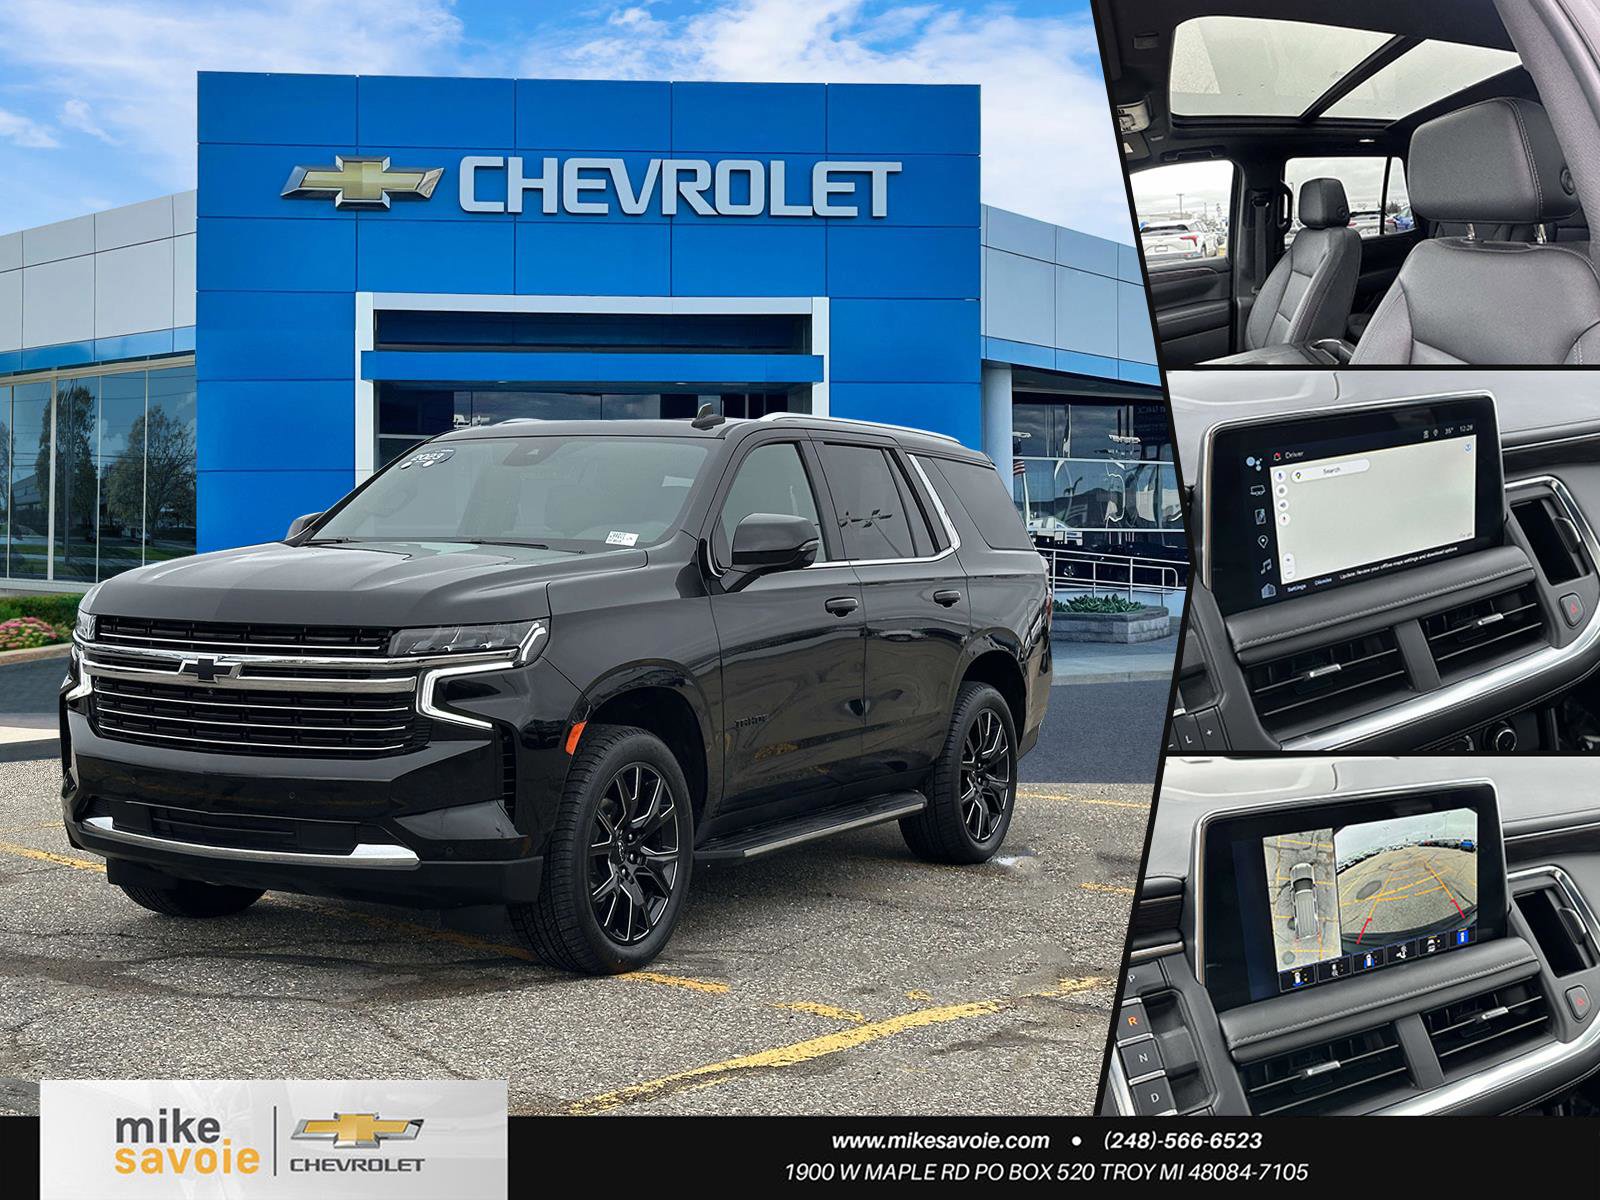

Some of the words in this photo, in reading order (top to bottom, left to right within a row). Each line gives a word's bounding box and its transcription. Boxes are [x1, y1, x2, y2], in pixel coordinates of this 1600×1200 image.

[459, 155, 903, 218] CHEVROLET
[1322, 466, 1342, 475] Search
[1128, 974, 1136, 983] P
[1127, 1015, 1138, 1026] R
[1138, 1052, 1149, 1063] N
[1150, 1092, 1160, 1103] D
